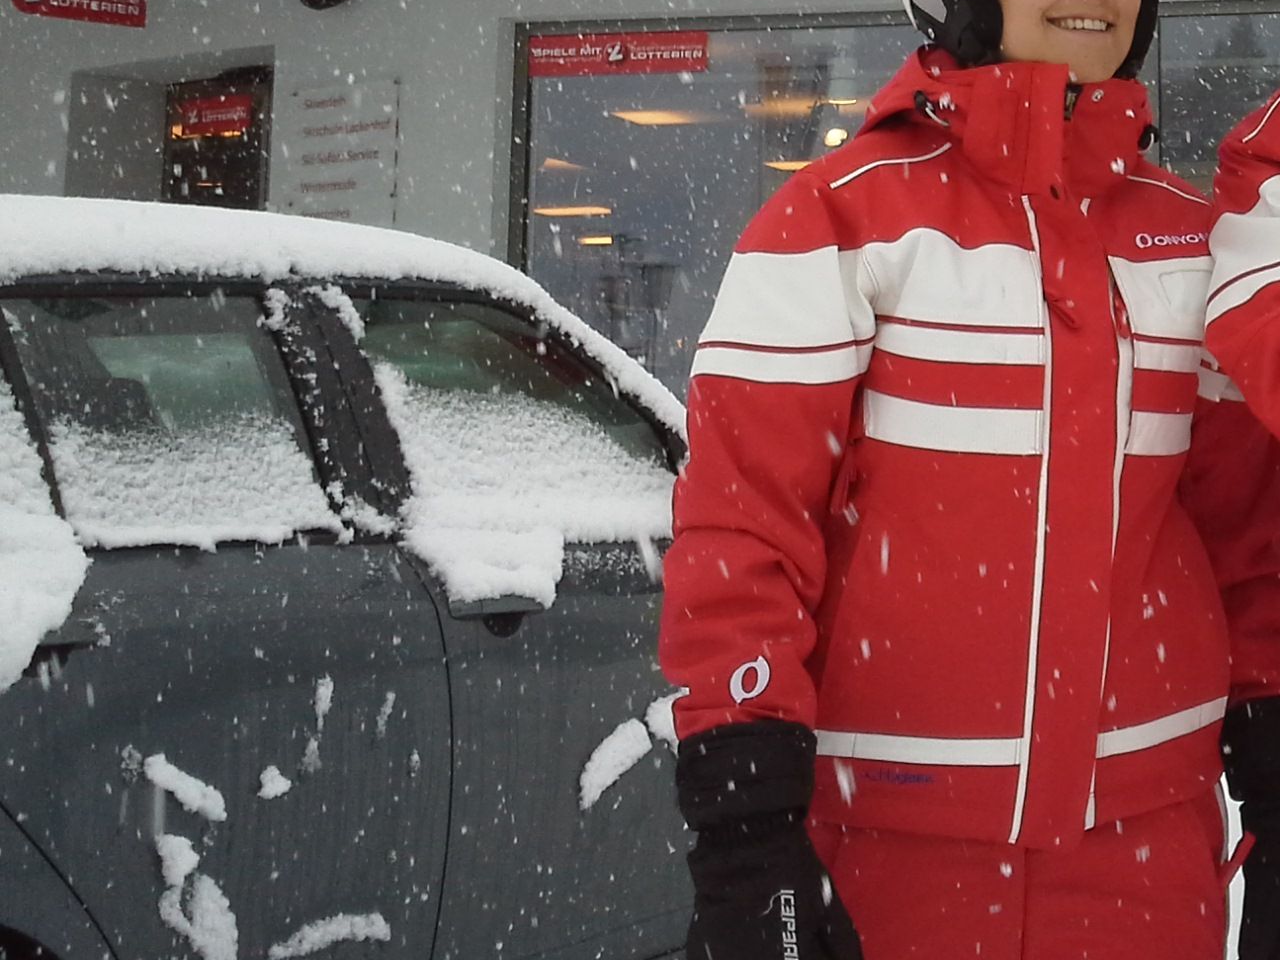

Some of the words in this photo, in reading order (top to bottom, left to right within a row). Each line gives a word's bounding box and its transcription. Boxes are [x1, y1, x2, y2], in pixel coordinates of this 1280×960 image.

[580, 45, 602, 56] MIT
[630, 49, 703, 60] LOTTERIEN
[780, 889, 799, 960] ICEPEA
